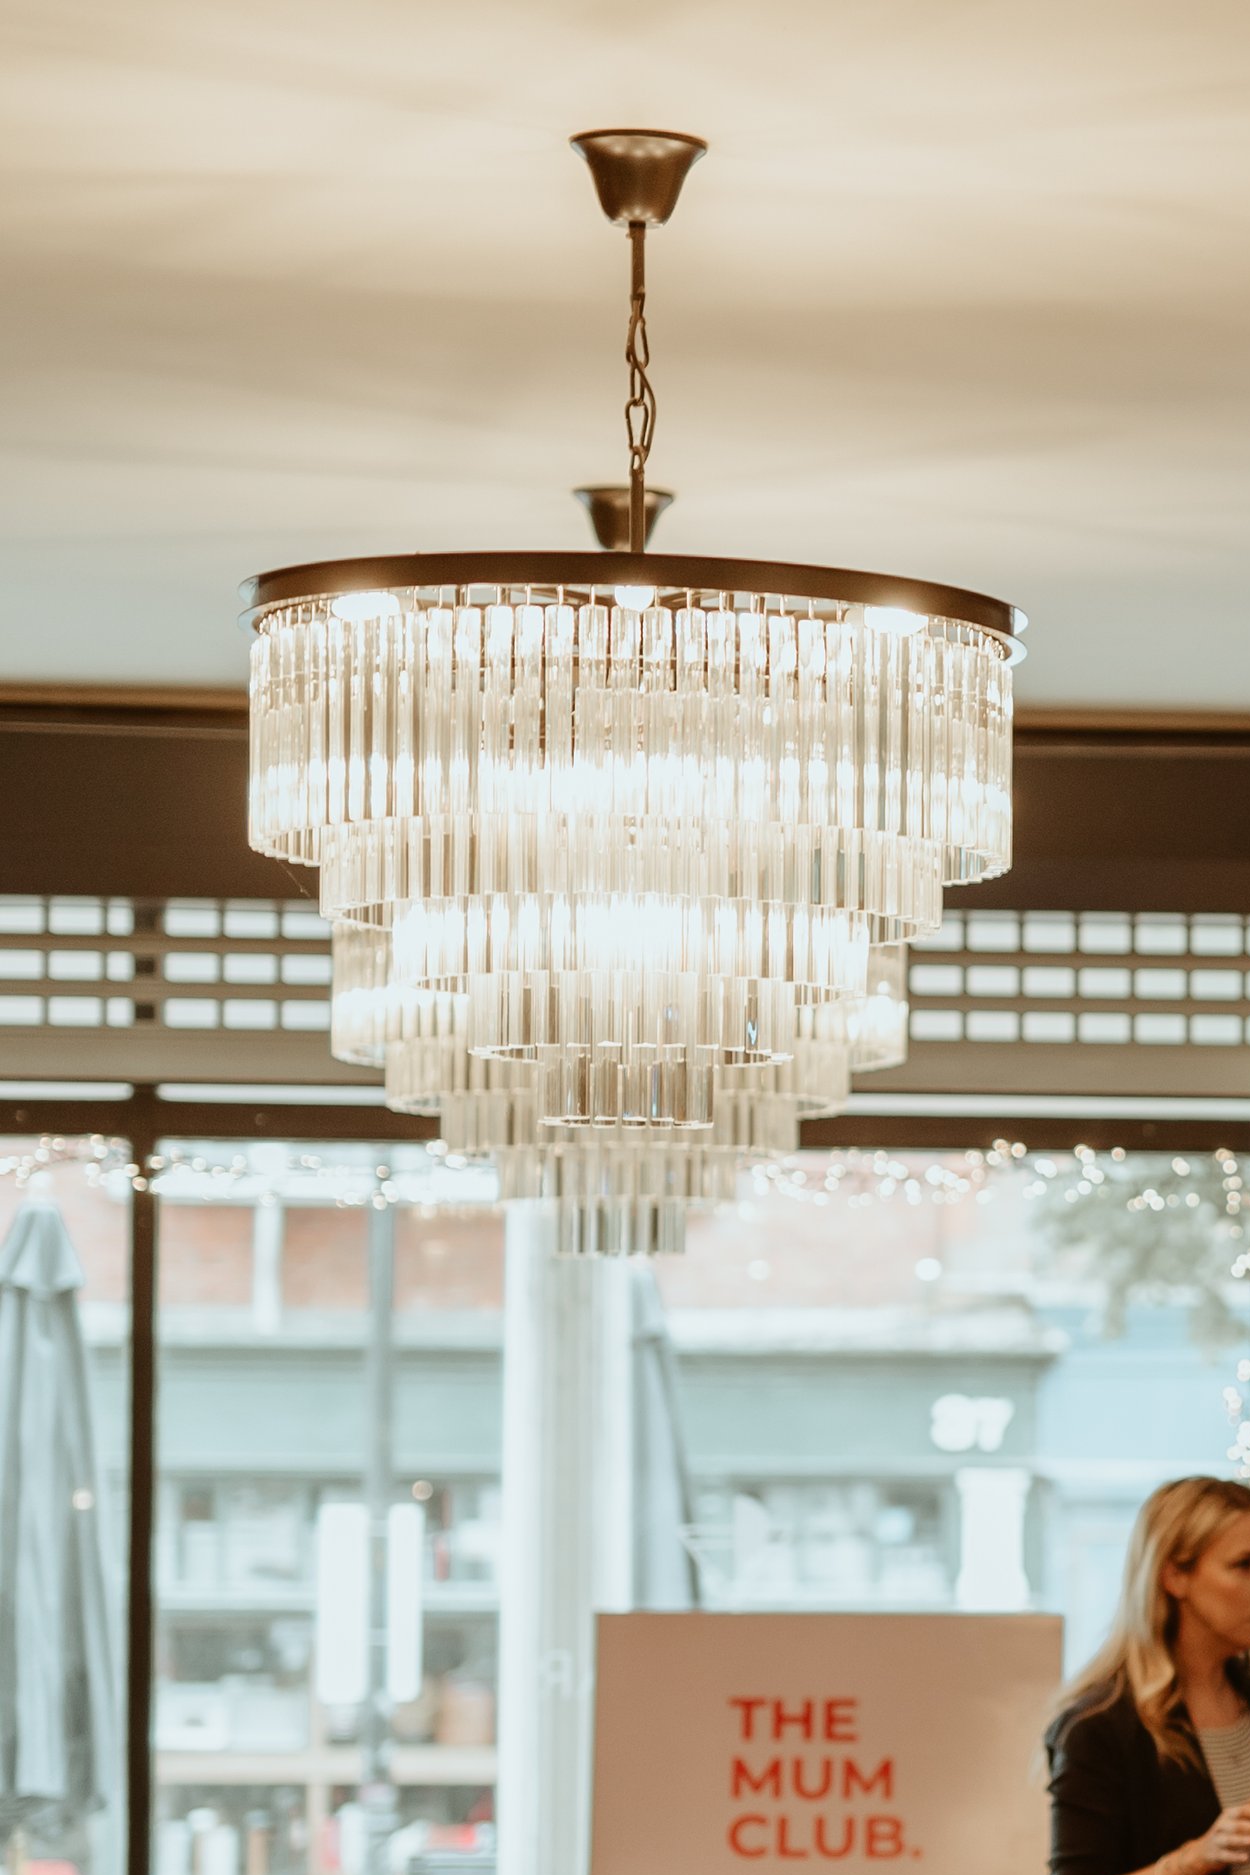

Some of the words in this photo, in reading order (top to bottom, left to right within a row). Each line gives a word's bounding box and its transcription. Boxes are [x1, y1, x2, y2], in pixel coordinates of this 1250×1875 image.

[729, 1697, 859, 1742] THE
[729, 1756, 894, 1801] MUM
[727, 1814, 922, 1861] CLUB.
